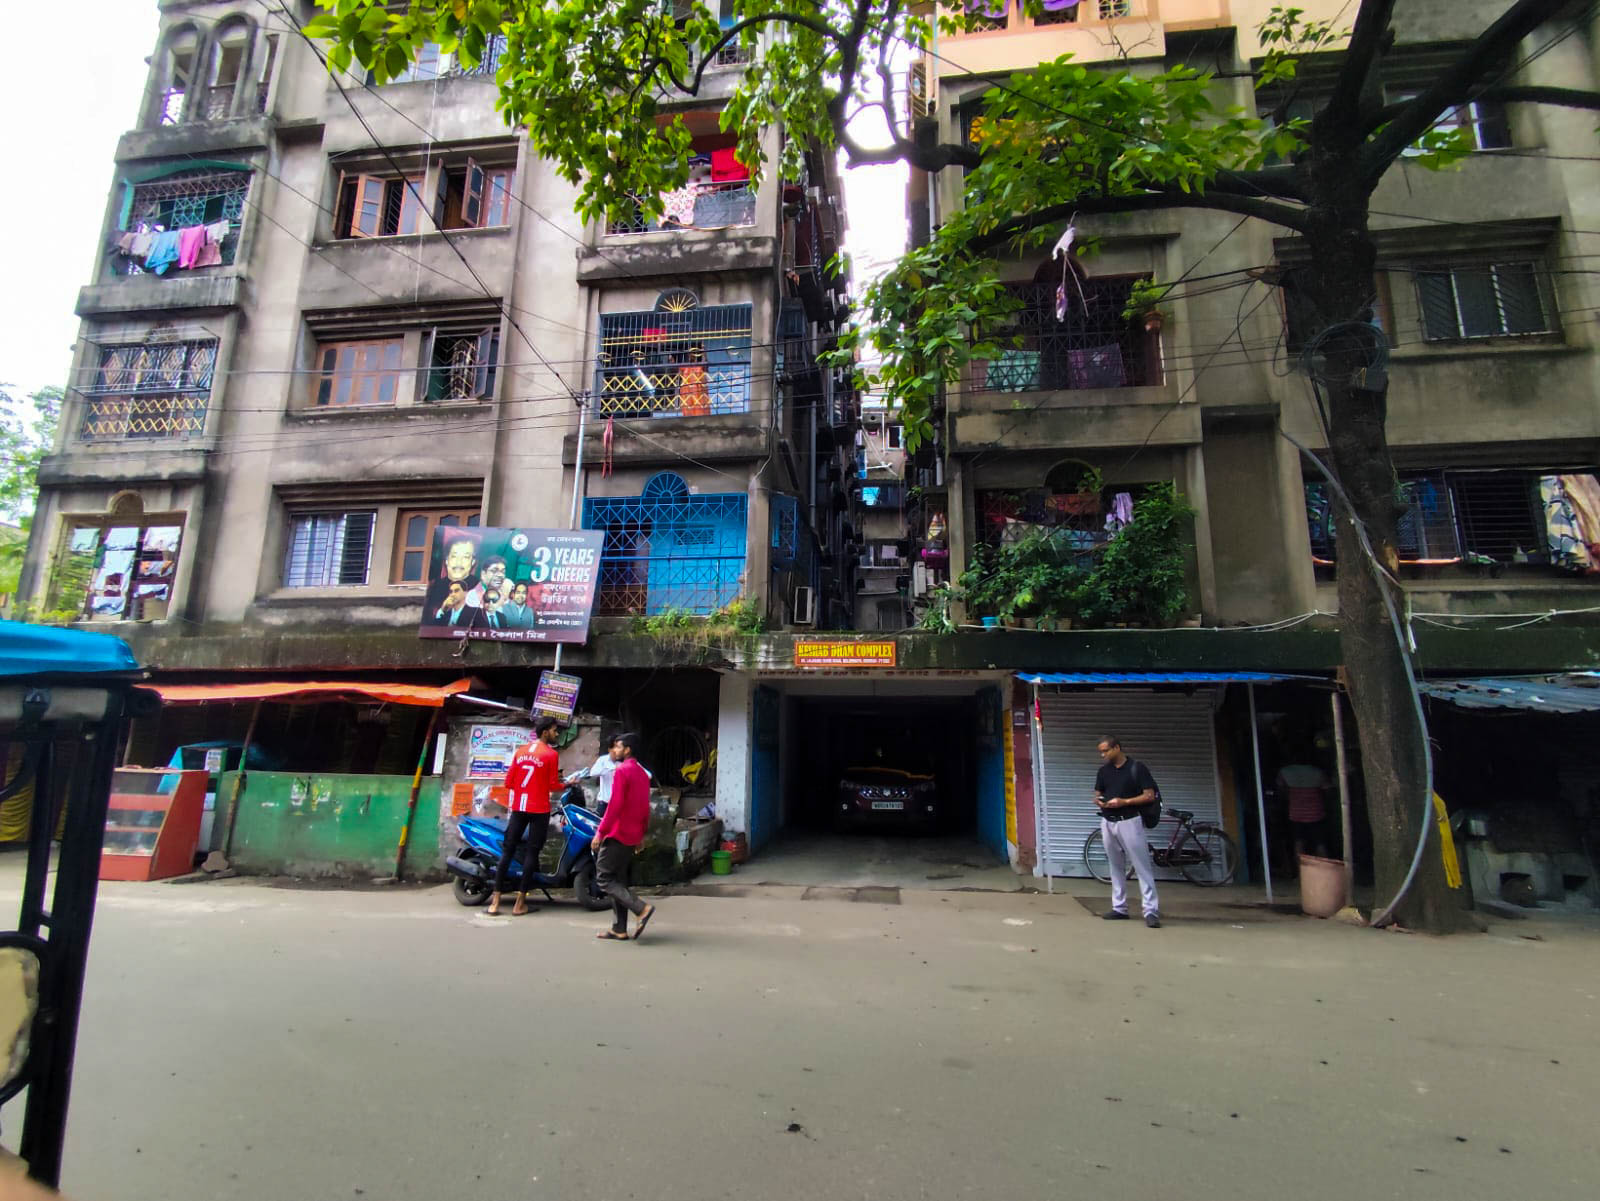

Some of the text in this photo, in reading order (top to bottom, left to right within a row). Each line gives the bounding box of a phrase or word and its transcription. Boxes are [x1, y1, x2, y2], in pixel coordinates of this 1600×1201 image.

[531, 547, 551, 582] 3
[555, 548, 594, 565] YEARS
[551, 567, 590, 582] CHEERS
[798, 644, 893, 657] KESHAB DHAM COMPLEX
[520, 765, 535, 788] 7
